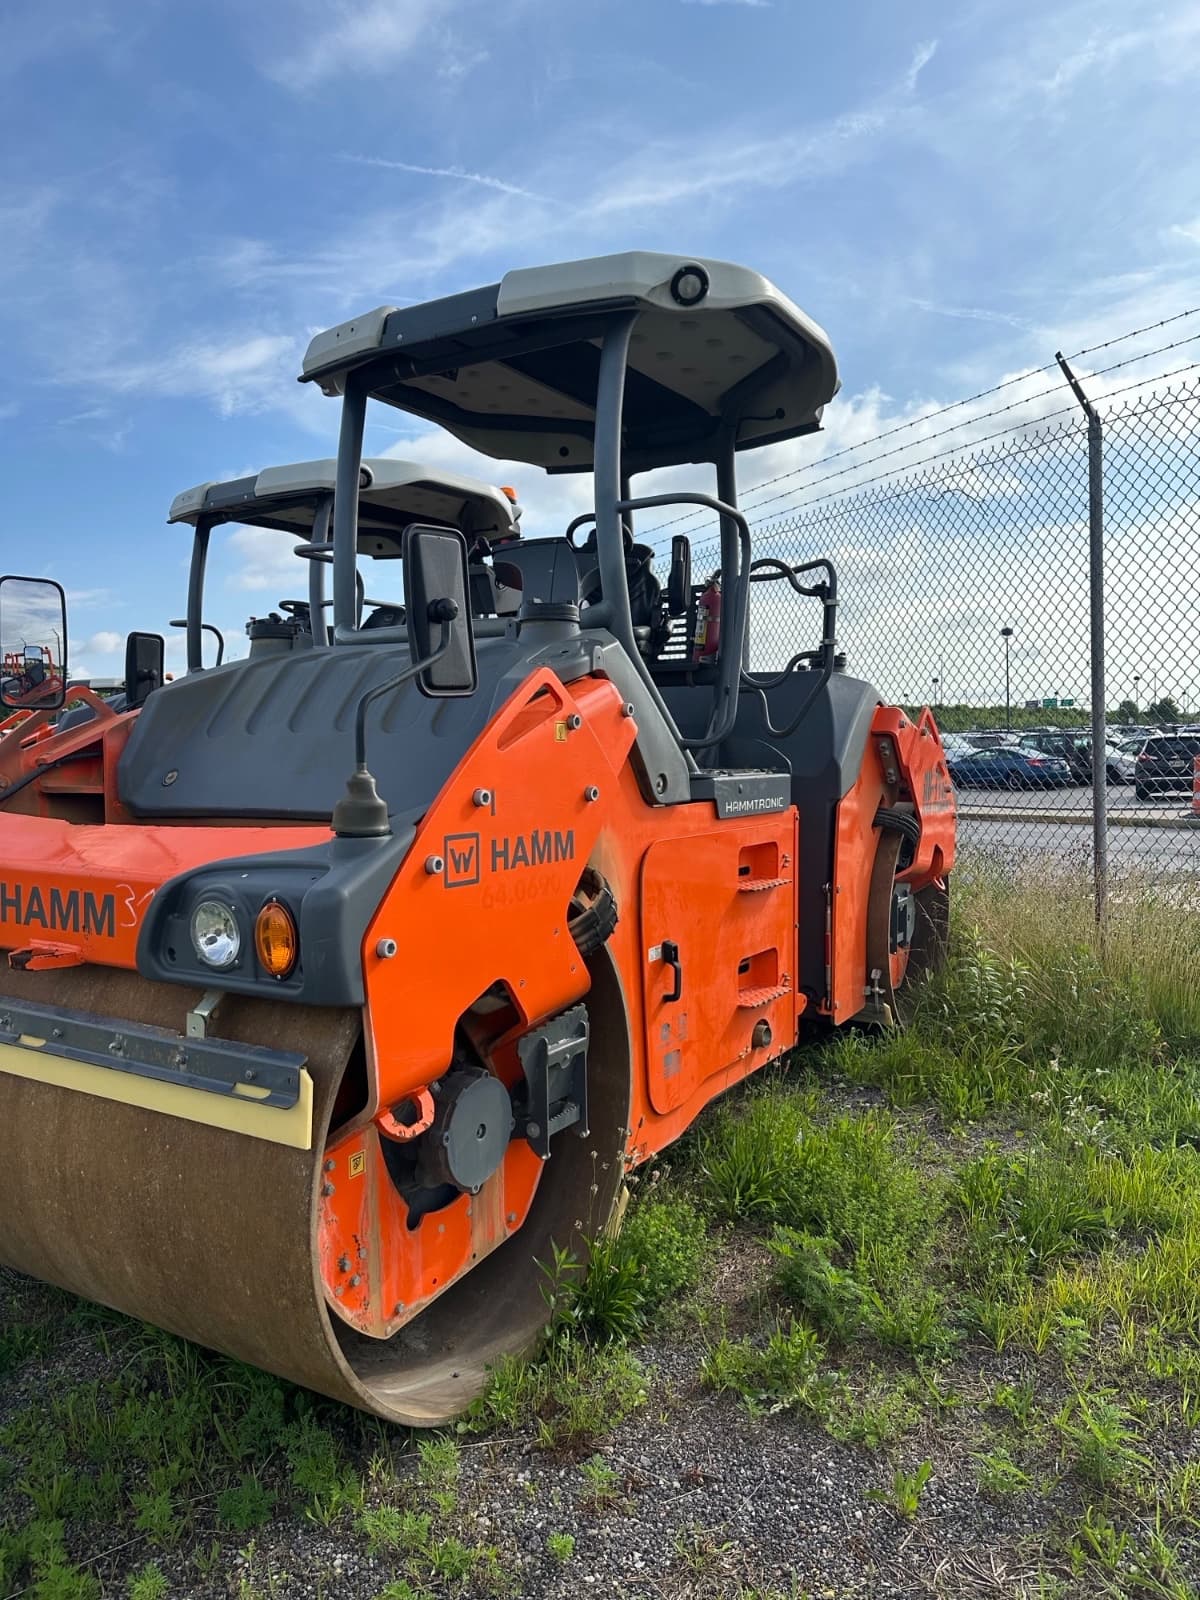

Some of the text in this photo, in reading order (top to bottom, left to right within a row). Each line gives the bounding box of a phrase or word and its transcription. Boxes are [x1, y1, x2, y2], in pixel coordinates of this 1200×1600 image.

[725, 796, 784, 813] HAMMTRONIC
[491, 829, 575, 872] HAMM
[0, 882, 115, 938] HAMM
